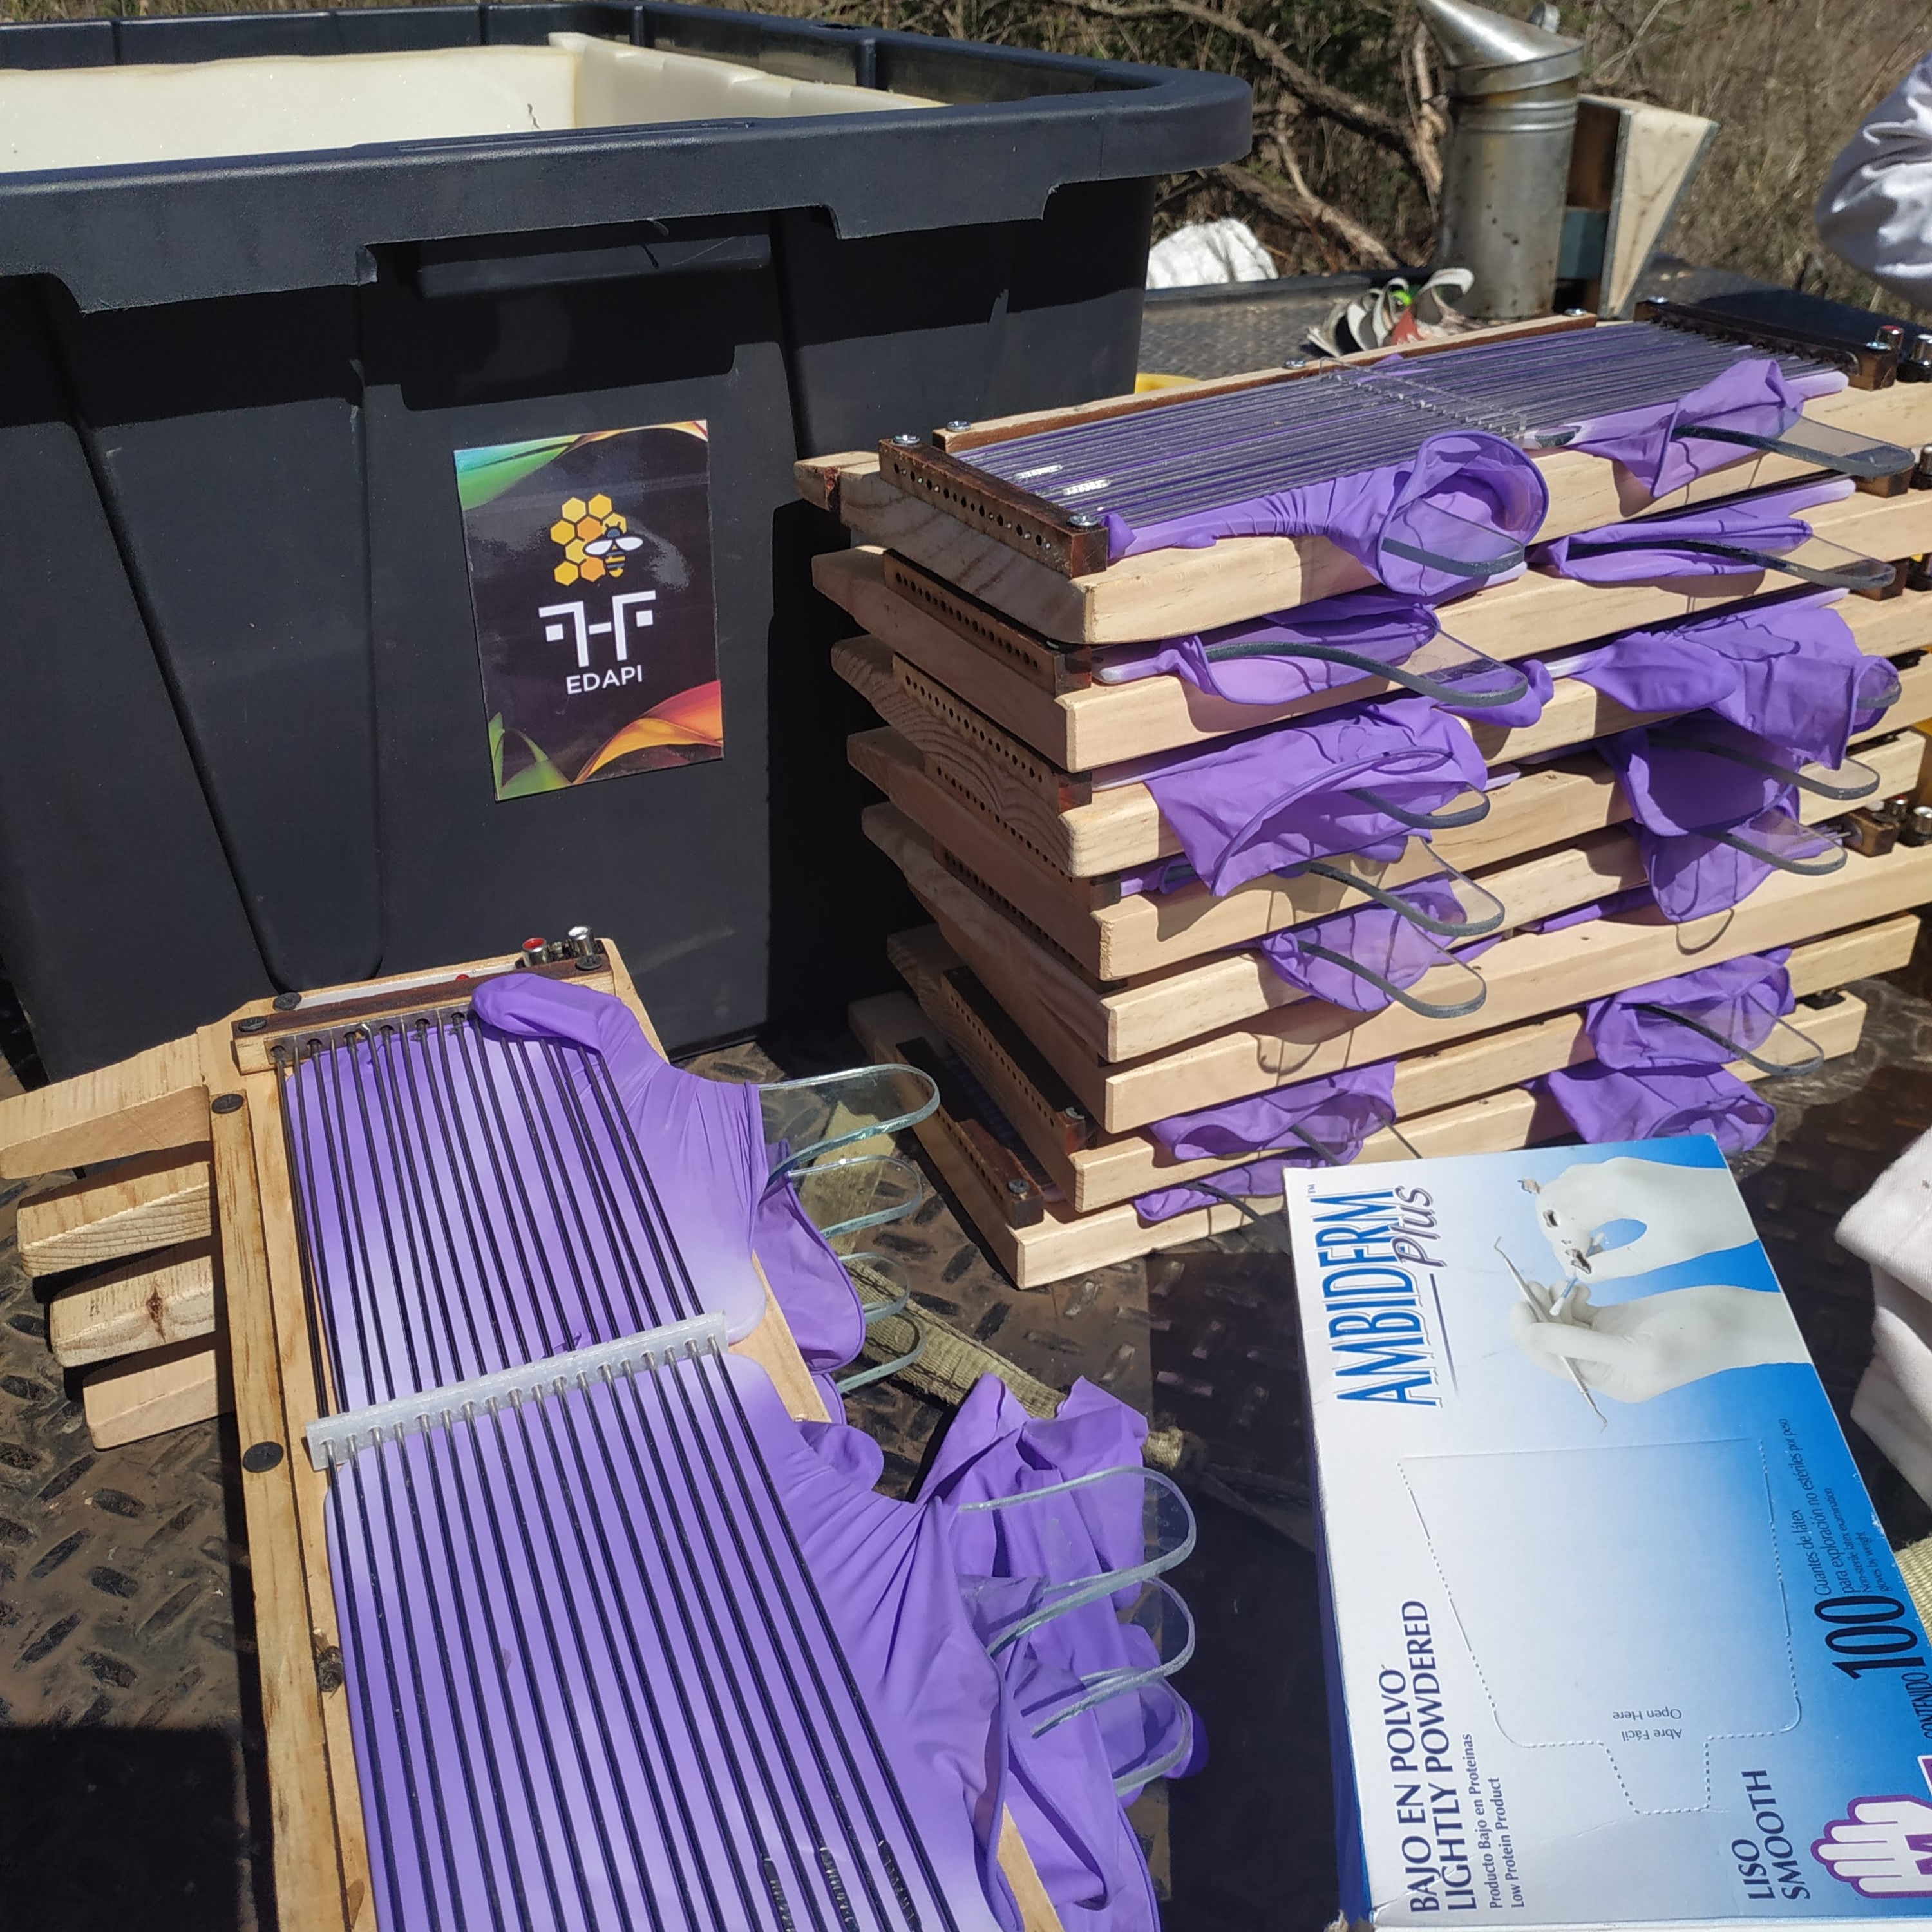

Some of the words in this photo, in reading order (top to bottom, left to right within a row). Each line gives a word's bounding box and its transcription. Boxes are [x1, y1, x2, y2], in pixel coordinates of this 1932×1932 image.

[566, 664, 643, 695] EDAPI
[1389, 1186, 1446, 1267] Plus
[1308, 1189, 1439, 1408] AMBIDERM
[1777, 1418, 1797, 1435] peso
[1785, 1438, 1803, 1451] por
[1788, 1453, 1812, 1490] estériles
[1804, 1493, 1820, 1506] no
[1824, 1488, 1848, 1531] examination
[1789, 1509, 1810, 1534] látex
[1808, 1508, 1845, 1567] exploración
[1795, 1535, 1815, 1549] de
[1841, 1532, 1855, 1551] latex
[1855, 1531, 1873, 1555] weight
[1804, 1551, 1832, 1596] Guantes
[1848, 1552, 1873, 1593] Non-sterile
[1866, 1558, 1879, 1568] by
[1871, 1569, 1892, 1592] gloves
[1835, 1570, 1861, 1594] para
[1814, 1595, 1926, 1680] 100
[1401, 1600, 1454, 1773] POWDERED
[1378, 1669, 1419, 1772] POLVO
[1612, 1710, 1643, 1721] Here
[1646, 1706, 1682, 1719] Open
[1621, 1730, 1650, 1742] Fácil
[1653, 1728, 1682, 1740] Abre
[1461, 1734, 1482, 1795] Proteinas
[1393, 1784, 1426, 1824] EN
[1473, 1799, 1485, 1815] en
[1488, 1777, 1510, 1830] Product
[1428, 1782, 1477, 1910] LIGHTLY
[1473, 1819, 1493, 1850] Bajo
[1741, 1770, 1810, 1899] SMOOTH
[1401, 1836, 1441, 1913] BAJO
[1497, 1835, 1519, 1881] Protein
[1731, 1839, 1776, 1899] LISO
[1477, 1853, 1503, 1909] Producto
[1508, 1884, 1524, 1908] Low
